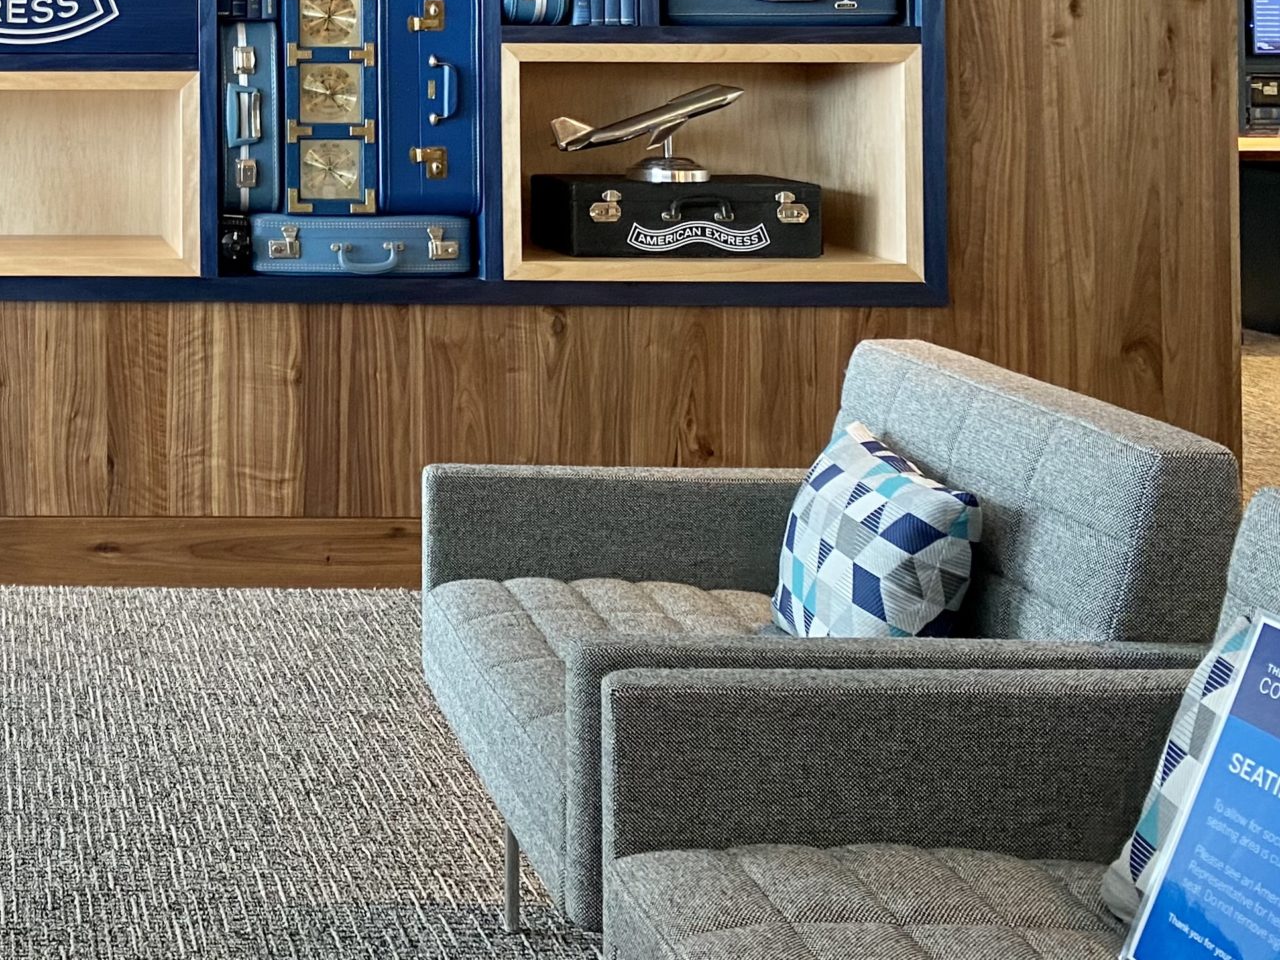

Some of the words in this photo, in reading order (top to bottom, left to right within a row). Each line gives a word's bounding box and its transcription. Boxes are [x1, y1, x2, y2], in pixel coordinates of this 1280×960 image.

[638, 227, 702, 245] AMERICAN
[705, 228, 759, 246] EXPRESS
[1228, 753, 1280, 798] SEATI
[1207, 816, 1239, 844] seating
[1240, 836, 1260, 854] area
[1214, 798, 1224, 812] To
[1224, 808, 1248, 826] allow
[1248, 819, 1262, 834] for
[1195, 844, 1224, 870] Please
[1224, 865, 1241, 881] see
[1241, 876, 1254, 889] an
[1188, 860, 1253, 909] Representative
[1254, 902, 1268, 916] for
[1169, 912, 1190, 934] Thank
[1188, 929, 1203, 943] you
[1204, 938, 1215, 950] for
[1204, 889, 1217, 906] Do
[1217, 901, 1234, 917] not
[1234, 912, 1267, 939] remove
